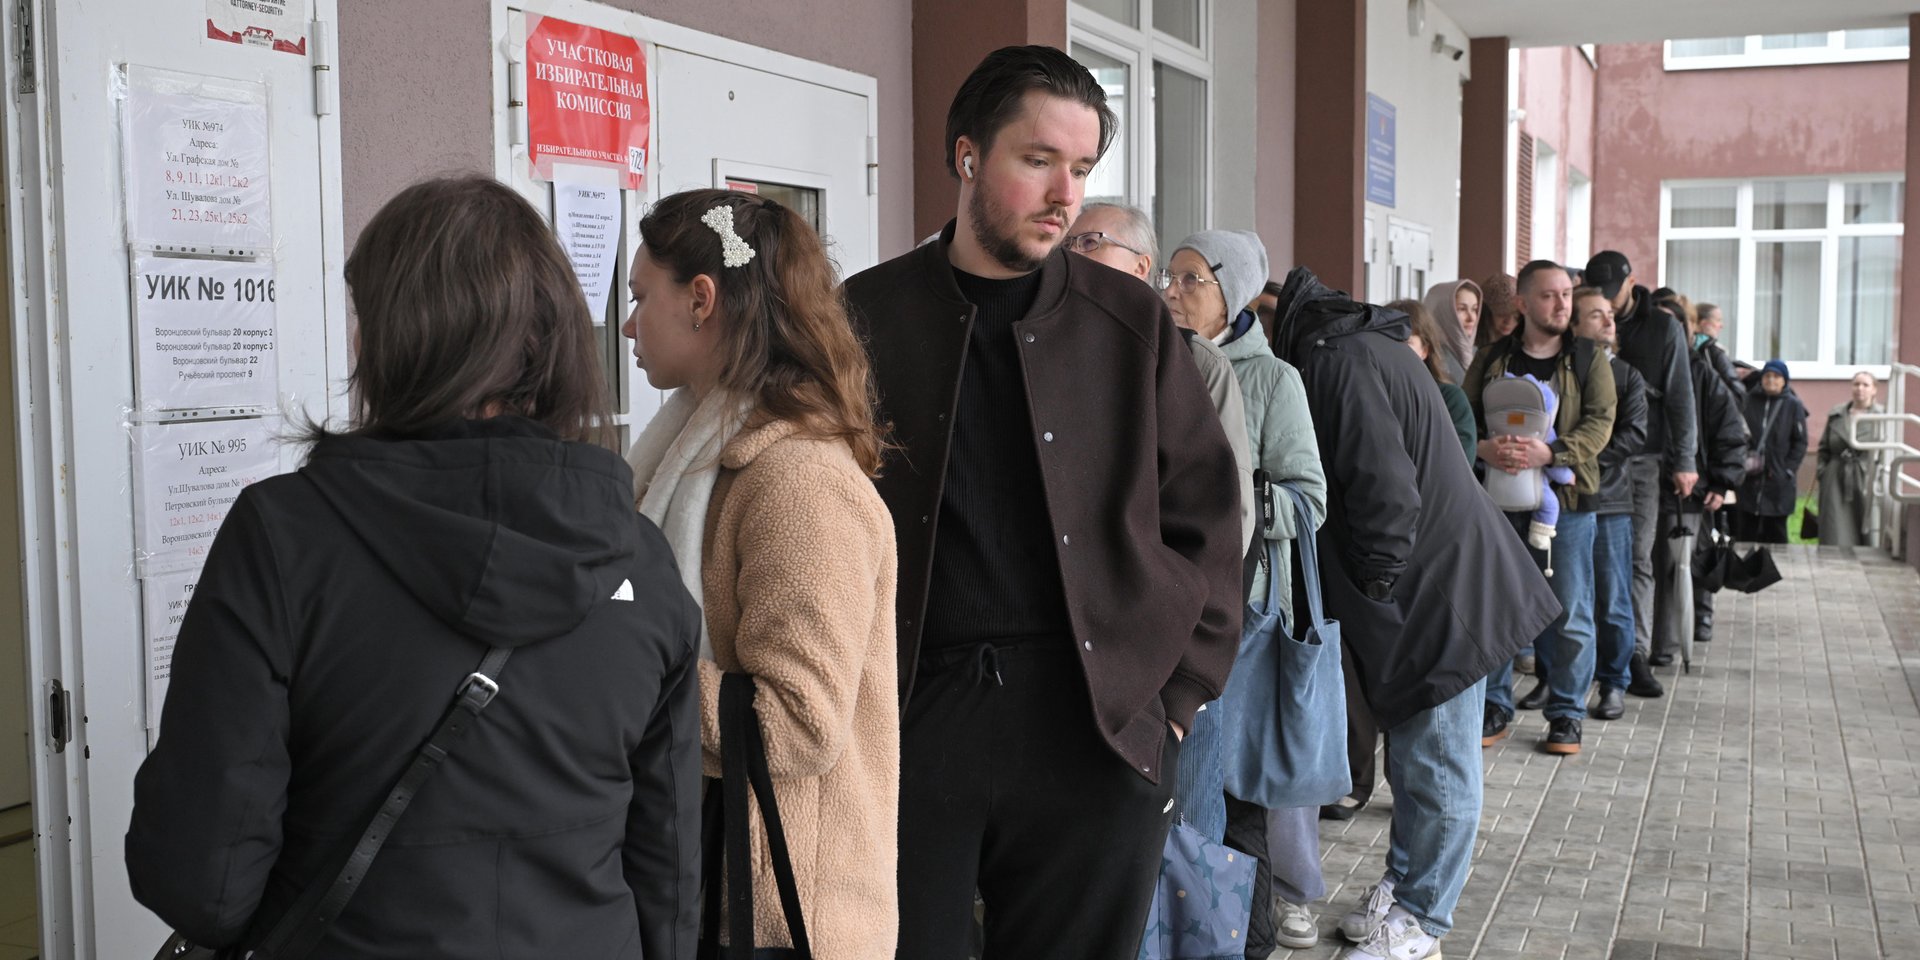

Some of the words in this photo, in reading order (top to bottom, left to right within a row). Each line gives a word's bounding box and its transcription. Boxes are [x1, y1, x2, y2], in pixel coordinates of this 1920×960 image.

[547, 39, 633, 73] УЧАСТКОВАЯ
[536, 62, 643, 99] ИЗБИРАТЕЛЬНАЯ
[556, 91, 631, 120] КОМИССИЯ
[182, 119, 200, 130] УИК
[203, 121, 224, 132] №974
[189, 138, 219, 150] Адреса:
[166, 151, 179, 162] Ул.
[180, 153, 216, 166] Графская
[217, 159, 229, 167] дом
[230, 158, 239, 168] №
[536, 143, 597, 159] ИЗБИРАТЕЛЬНОГО
[598, 151, 624, 163] УЧАСТКА
[630, 149, 643, 170] 972
[166, 170, 175, 183] 8,
[176, 171, 186, 184] 9,
[189, 171, 202, 185] 11,
[205, 173, 226, 188] 12к1,
[228, 175, 249, 188] 12к2
[166, 190, 179, 200] Ул.
[181, 191, 217, 204] Шувалова
[232, 196, 241, 205] №
[171, 208, 186, 221] 21,
[189, 209, 203, 223] 23,
[204, 210, 227, 224] 25к1,
[228, 212, 248, 225] 25к2
[145, 274, 191, 300] УИК
[198, 276, 225, 301] №
[234, 278, 275, 302] 1016
[155, 327, 201, 338] Воронцовский
[202, 327, 231, 339] бульвар
[233, 328, 242, 337] 20
[243, 330, 268, 338] корпус
[156, 342, 202, 353] Воронцовский
[203, 342, 231, 353] бульвар
[233, 342, 241, 350] 20
[243, 344, 268, 352] корпус
[269, 342, 273, 350] 3
[172, 356, 218, 367] Воронцовский
[219, 356, 248, 366] бульвар
[249, 356, 258, 364] 22
[216, 371, 247, 380] проспект
[248, 370, 253, 378] 9
[178, 441, 208, 460] УИК
[211, 440, 226, 454] №
[228, 438, 247, 453] 995
[198, 465, 228, 477] Адреса:
[168, 483, 215, 496] Ул.Шувалова
[216, 481, 231, 490] дом
[231, 478, 240, 488] №
[165, 498, 207, 511] Петровский
[207, 496, 237, 508] бульвар
[162, 528, 212, 544] Воронцовский
[168, 600, 182, 609] УИК
[169, 614, 184, 624] УИК
